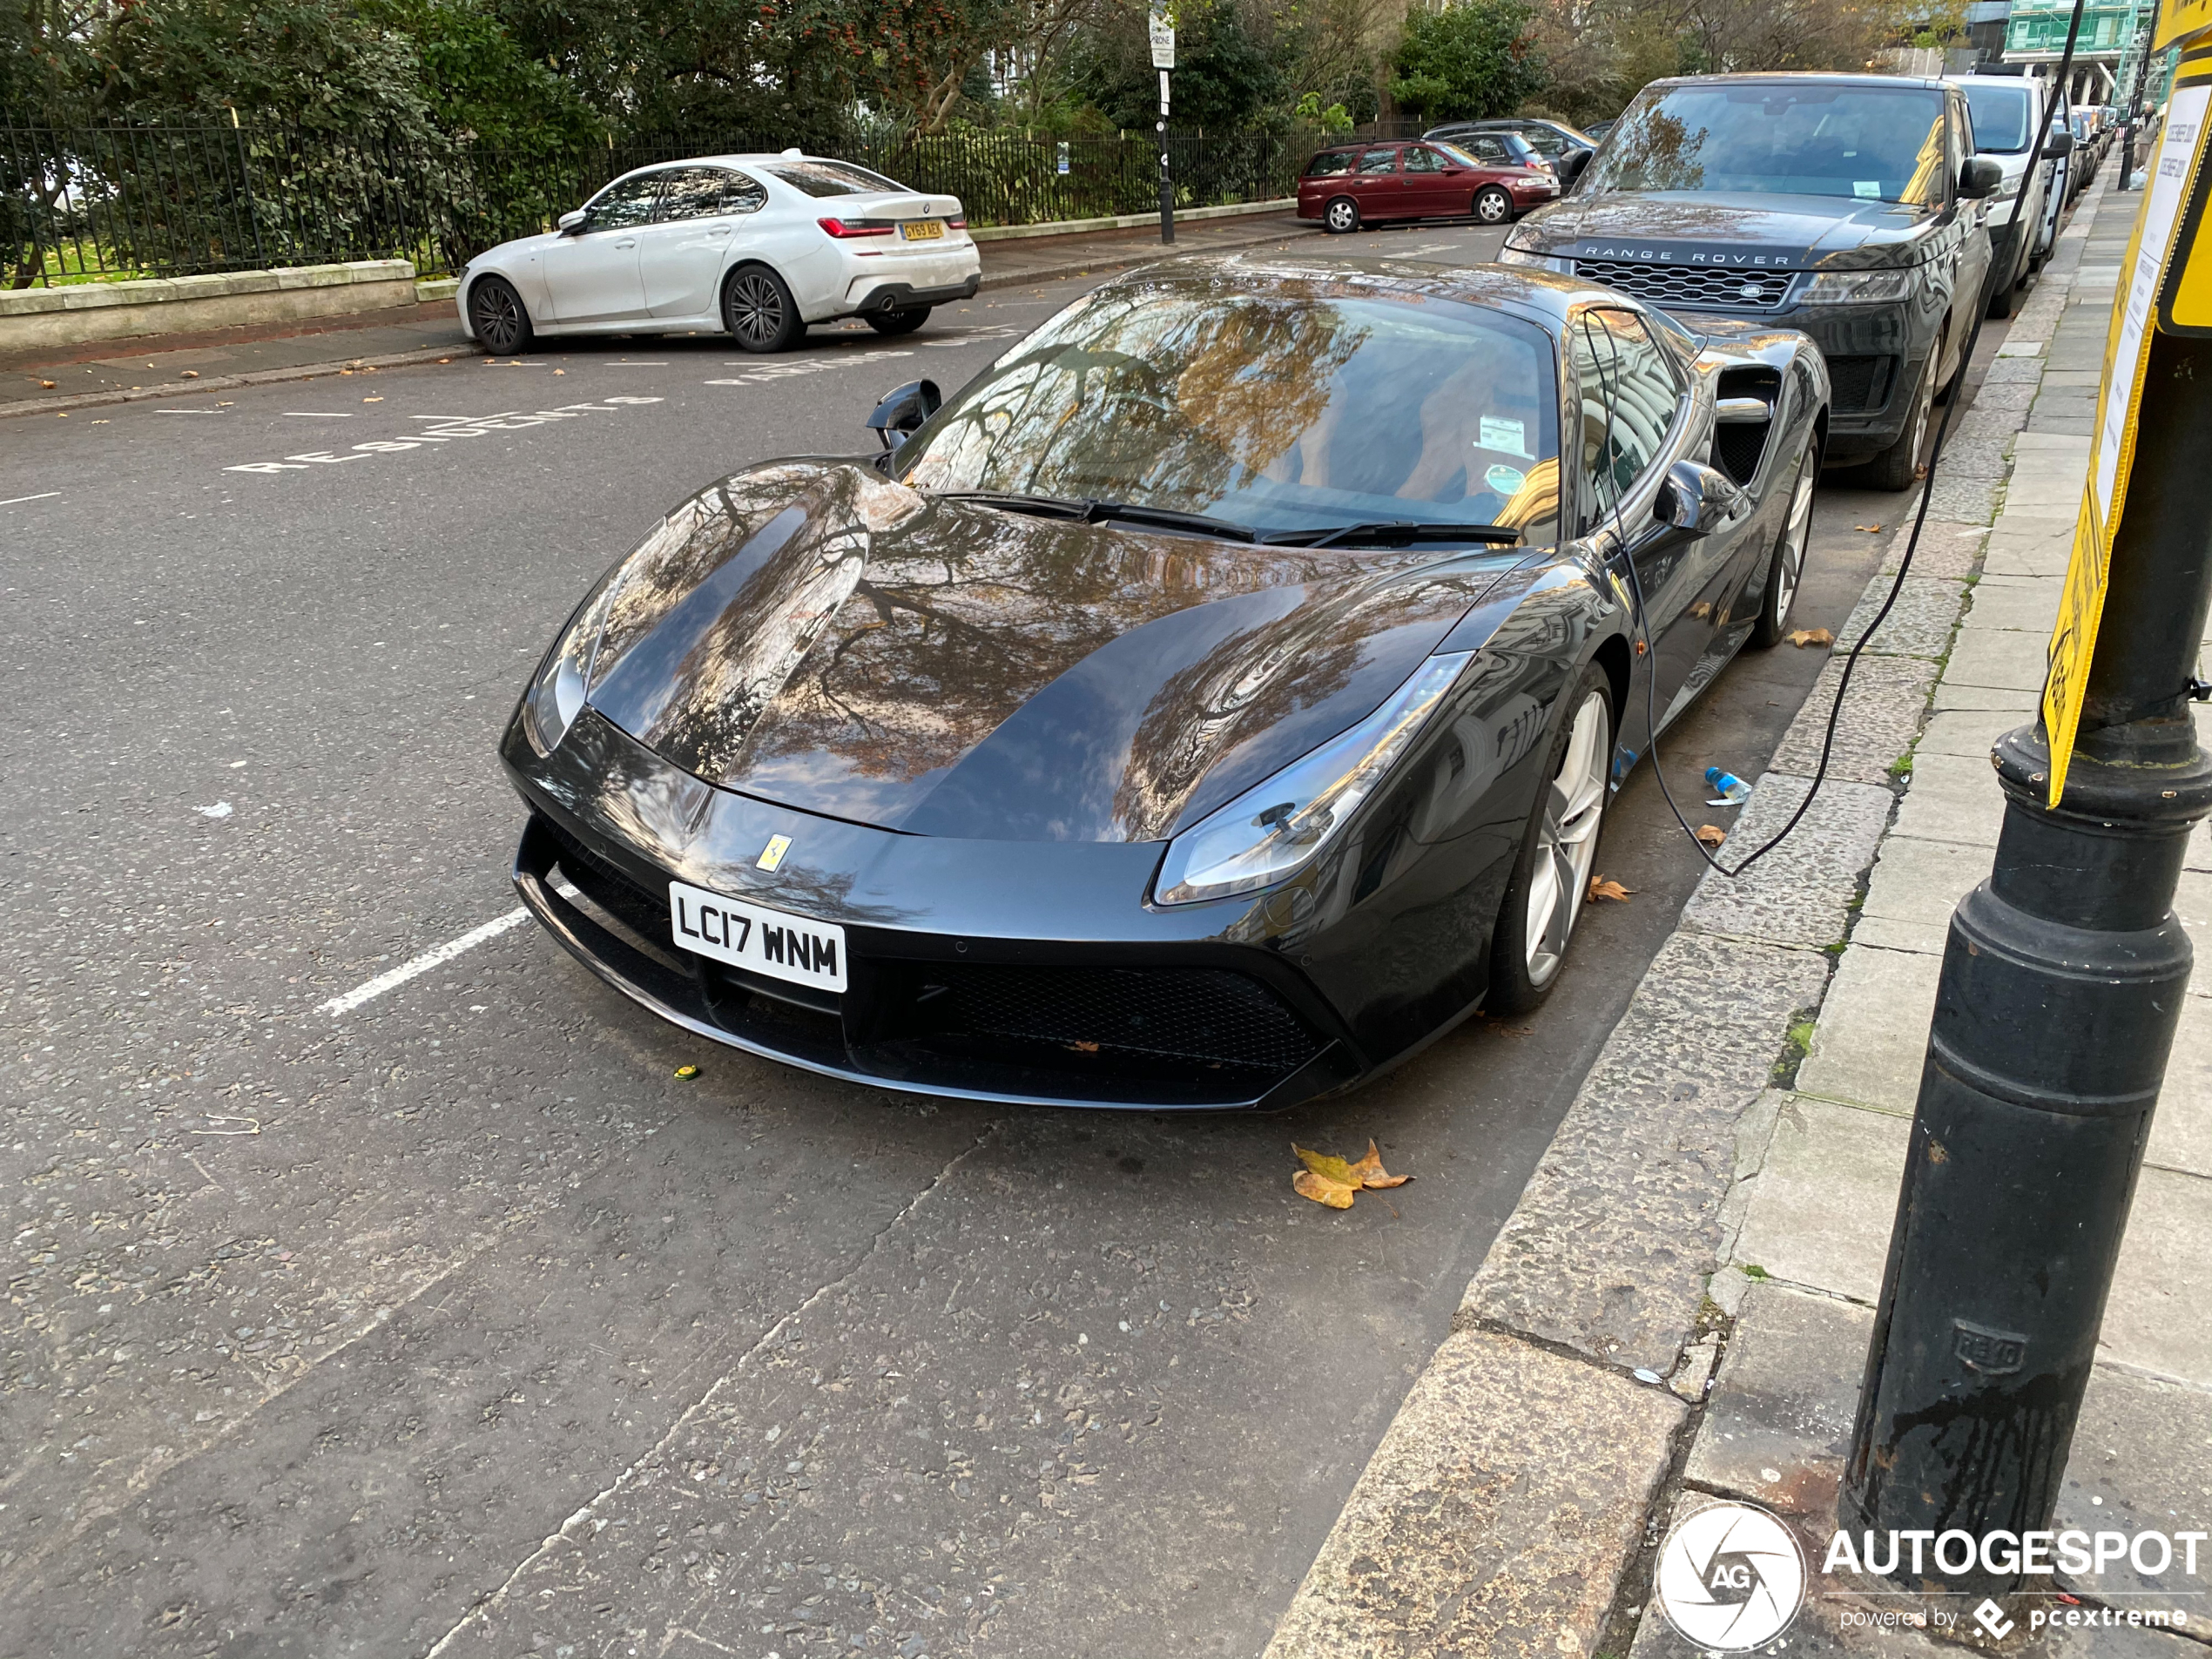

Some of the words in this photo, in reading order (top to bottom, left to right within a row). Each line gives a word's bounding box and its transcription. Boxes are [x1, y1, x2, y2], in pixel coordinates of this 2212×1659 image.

[927, 223, 941, 236] AEK
[1585, 246, 1673, 260] RANGE
[1691, 253, 1790, 266] ROVER
[703, 352, 914, 385] PARKING
[921, 329, 1028, 347] ONLY
[221, 396, 665, 474] RESIDENTS
[678, 896, 752, 954] LC17
[761, 921, 839, 977] WNM
